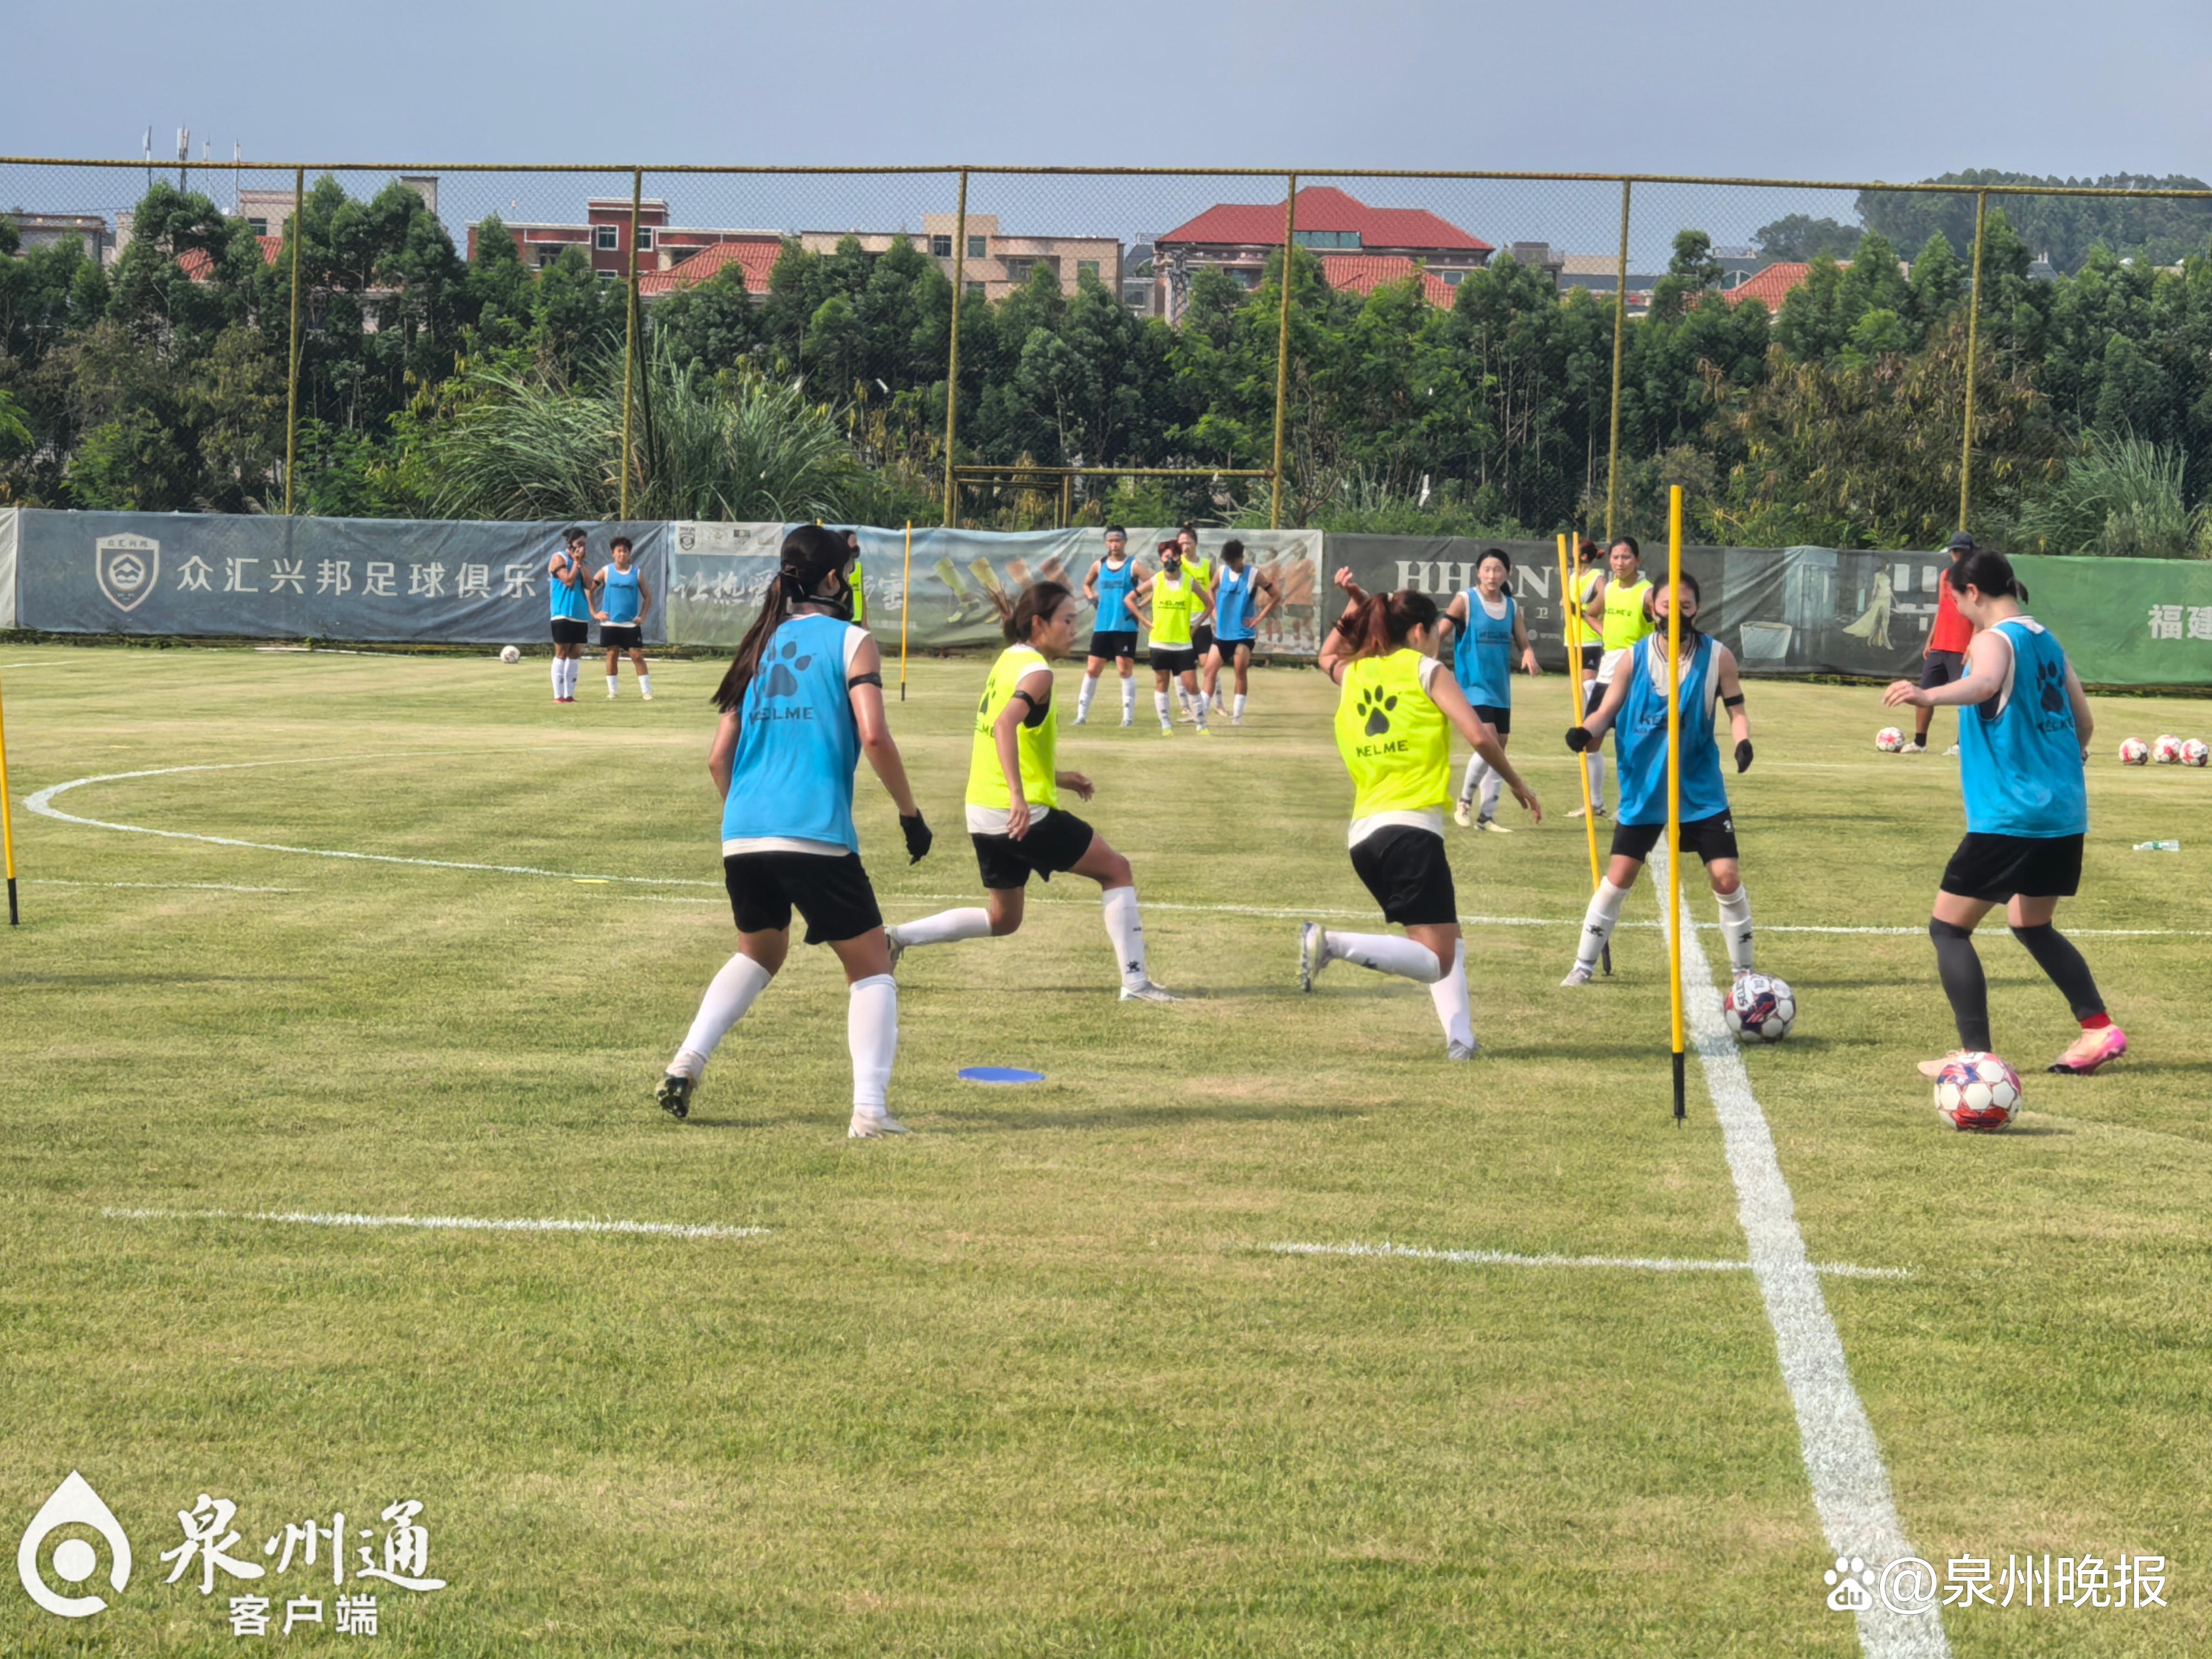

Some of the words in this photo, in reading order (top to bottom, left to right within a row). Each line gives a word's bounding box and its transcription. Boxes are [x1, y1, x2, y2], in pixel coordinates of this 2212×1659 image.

[177, 555, 550, 598] 众汇兴邦足球俱乐
[1395, 561, 1554, 599] HHN
[1356, 740, 1409, 757] KELME
